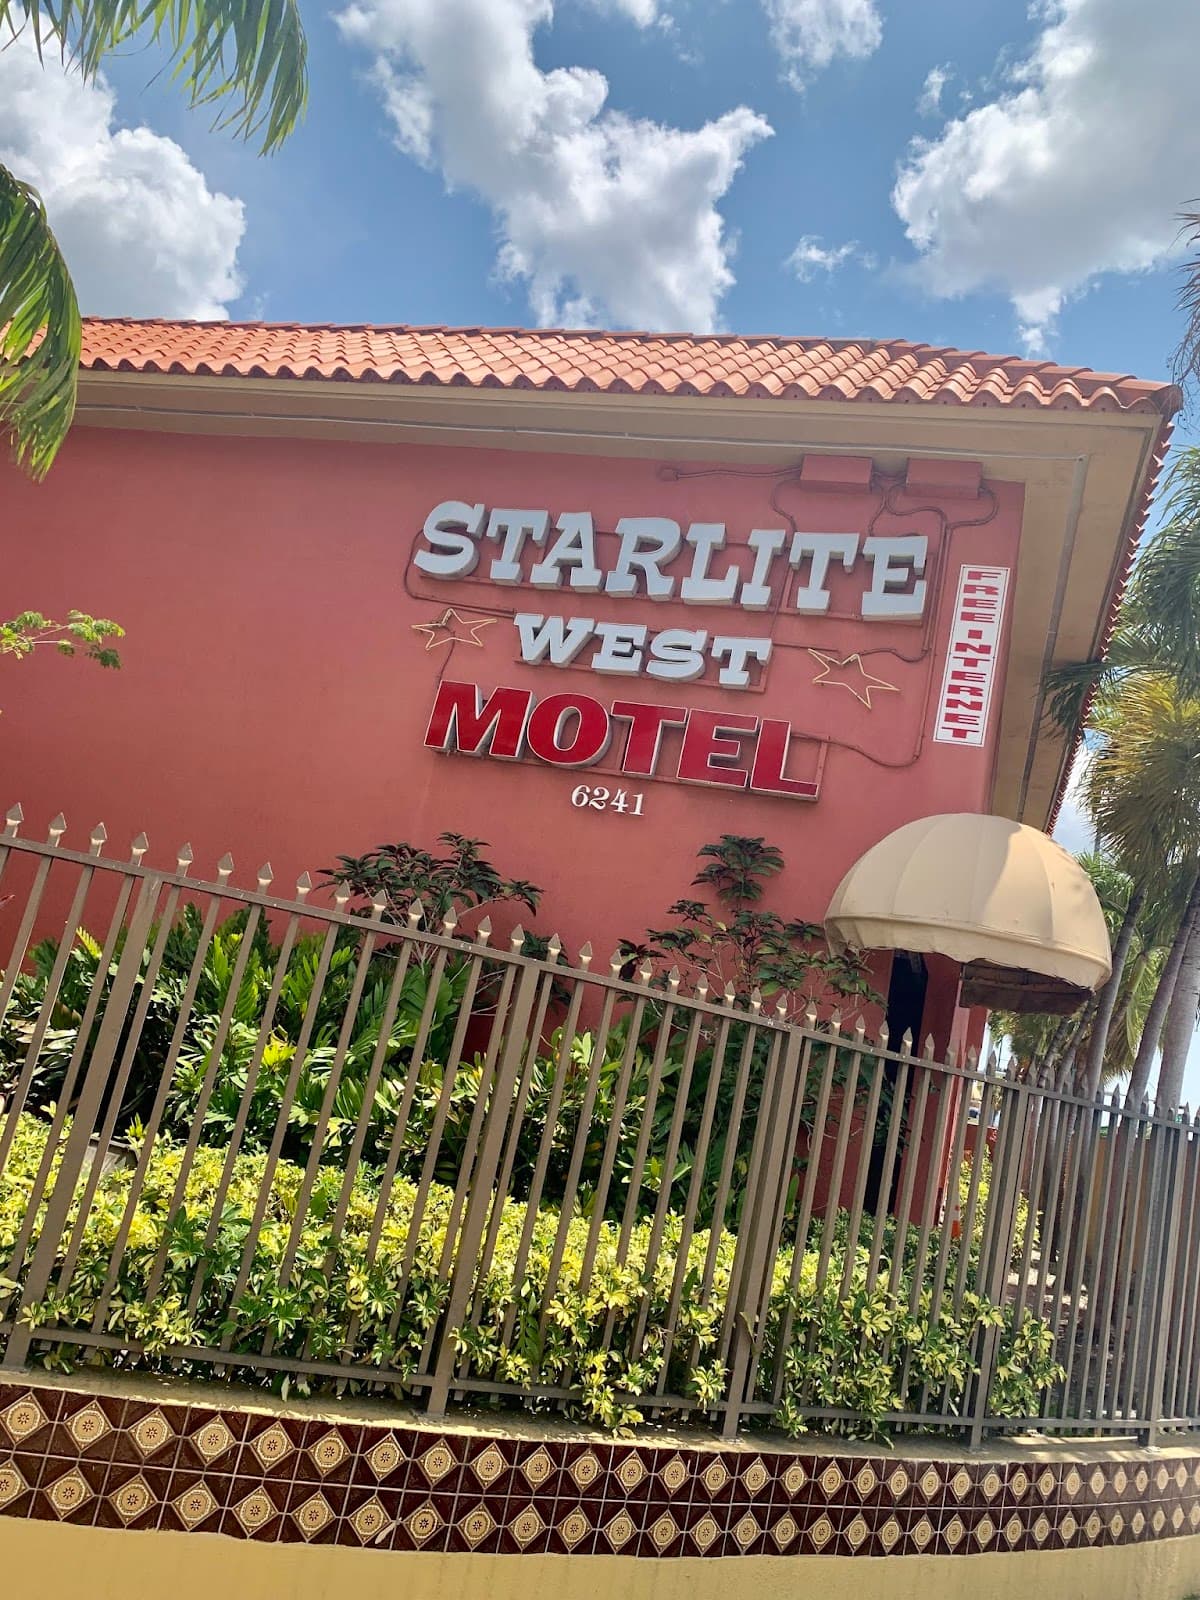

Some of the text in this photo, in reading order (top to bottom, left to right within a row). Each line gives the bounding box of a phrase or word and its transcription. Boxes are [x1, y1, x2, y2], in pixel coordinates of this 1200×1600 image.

[413, 500, 929, 621] STARLITE
[513, 613, 772, 690] WEST
[941, 570, 1001, 739] FREE INTERNET
[424, 680, 820, 801] MOTEL
[571, 784, 644, 816] 6241
